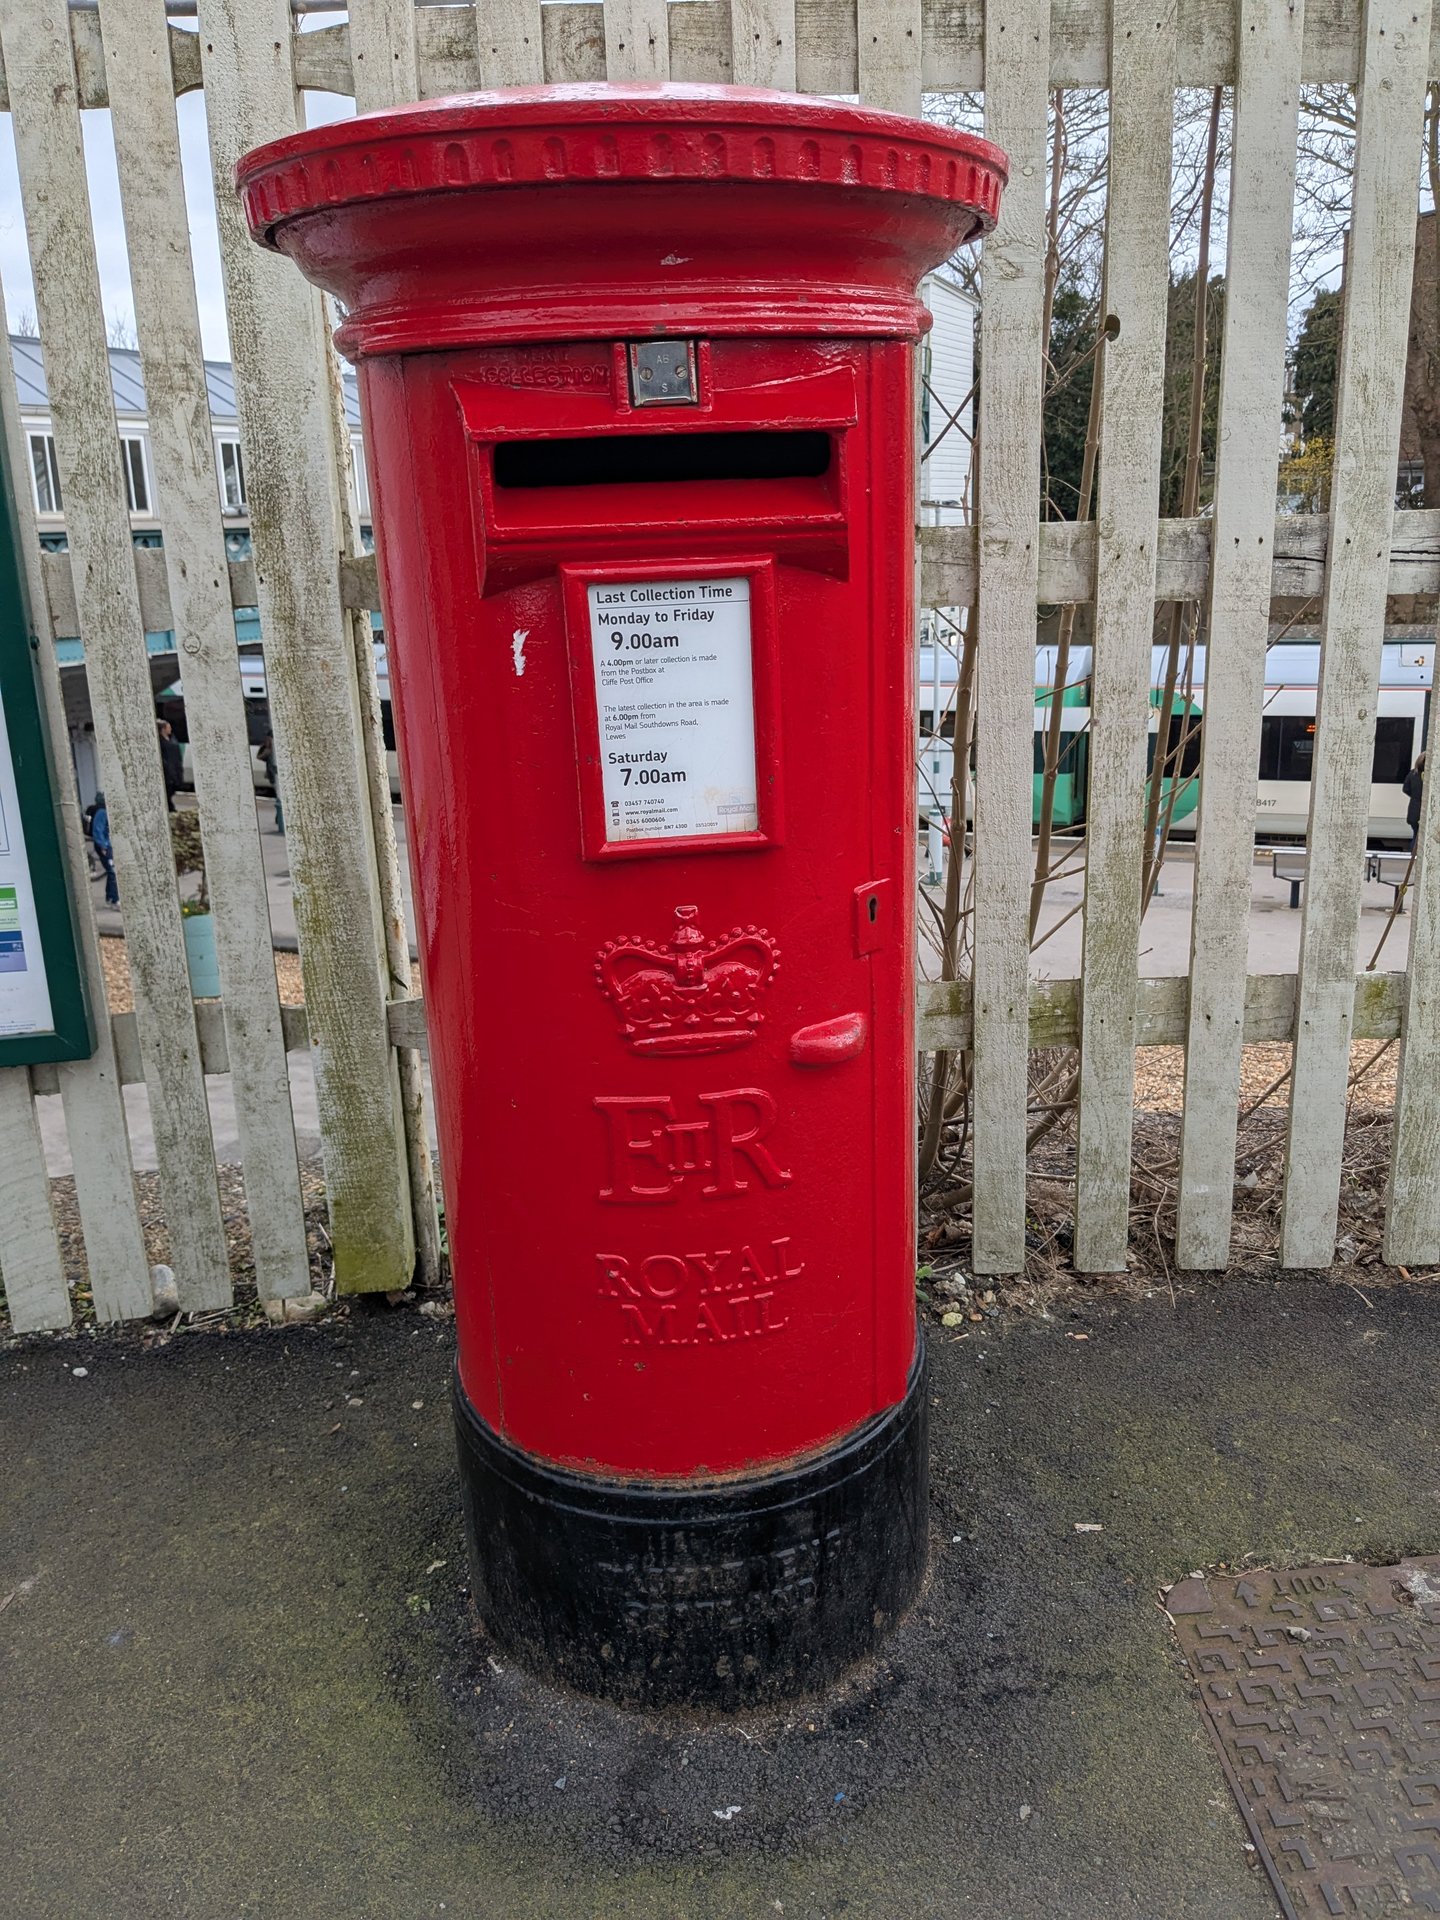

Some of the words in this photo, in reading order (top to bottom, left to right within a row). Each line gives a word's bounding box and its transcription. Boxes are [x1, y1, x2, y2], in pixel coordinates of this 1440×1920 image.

[661, 382, 669, 393] S
[596, 591, 625, 604] Last
[630, 588, 695, 602] Collection
[699, 586, 733, 599] Time
[598, 611, 650, 626] Monday
[655, 612, 668, 623] to
[673, 609, 715, 622] Friday
[610, 631, 679, 651] 9.00am
[607, 659, 634, 667] 4.00pm
[644, 657, 658, 665] later
[660, 656, 690, 664] collection
[601, 669, 617, 677] from
[619, 668, 629, 676] the
[631, 667, 657, 675] Postbox
[602, 678, 618, 686] Cliffe
[620, 677, 634, 685] Post
[636, 676, 653, 684] Office
[618, 704, 636, 712] latest
[637, 702, 667, 710] collection
[711, 698, 729, 706] made
[612, 713, 639, 721] 6.00pm
[605, 723, 623, 732] Royal
[624, 722, 638, 730] Mail
[640, 720, 679, 729] Southdowns
[608, 750, 668, 764] Saturday
[620, 768, 687, 786] 7.00am
[625, 799, 642, 807] 03457
[625, 807, 678, 816] www.royalmail.com
[719, 805, 737, 814] Royal
[596, 1237, 805, 1298] ROYAL
[622, 1291, 789, 1345] MAIL
